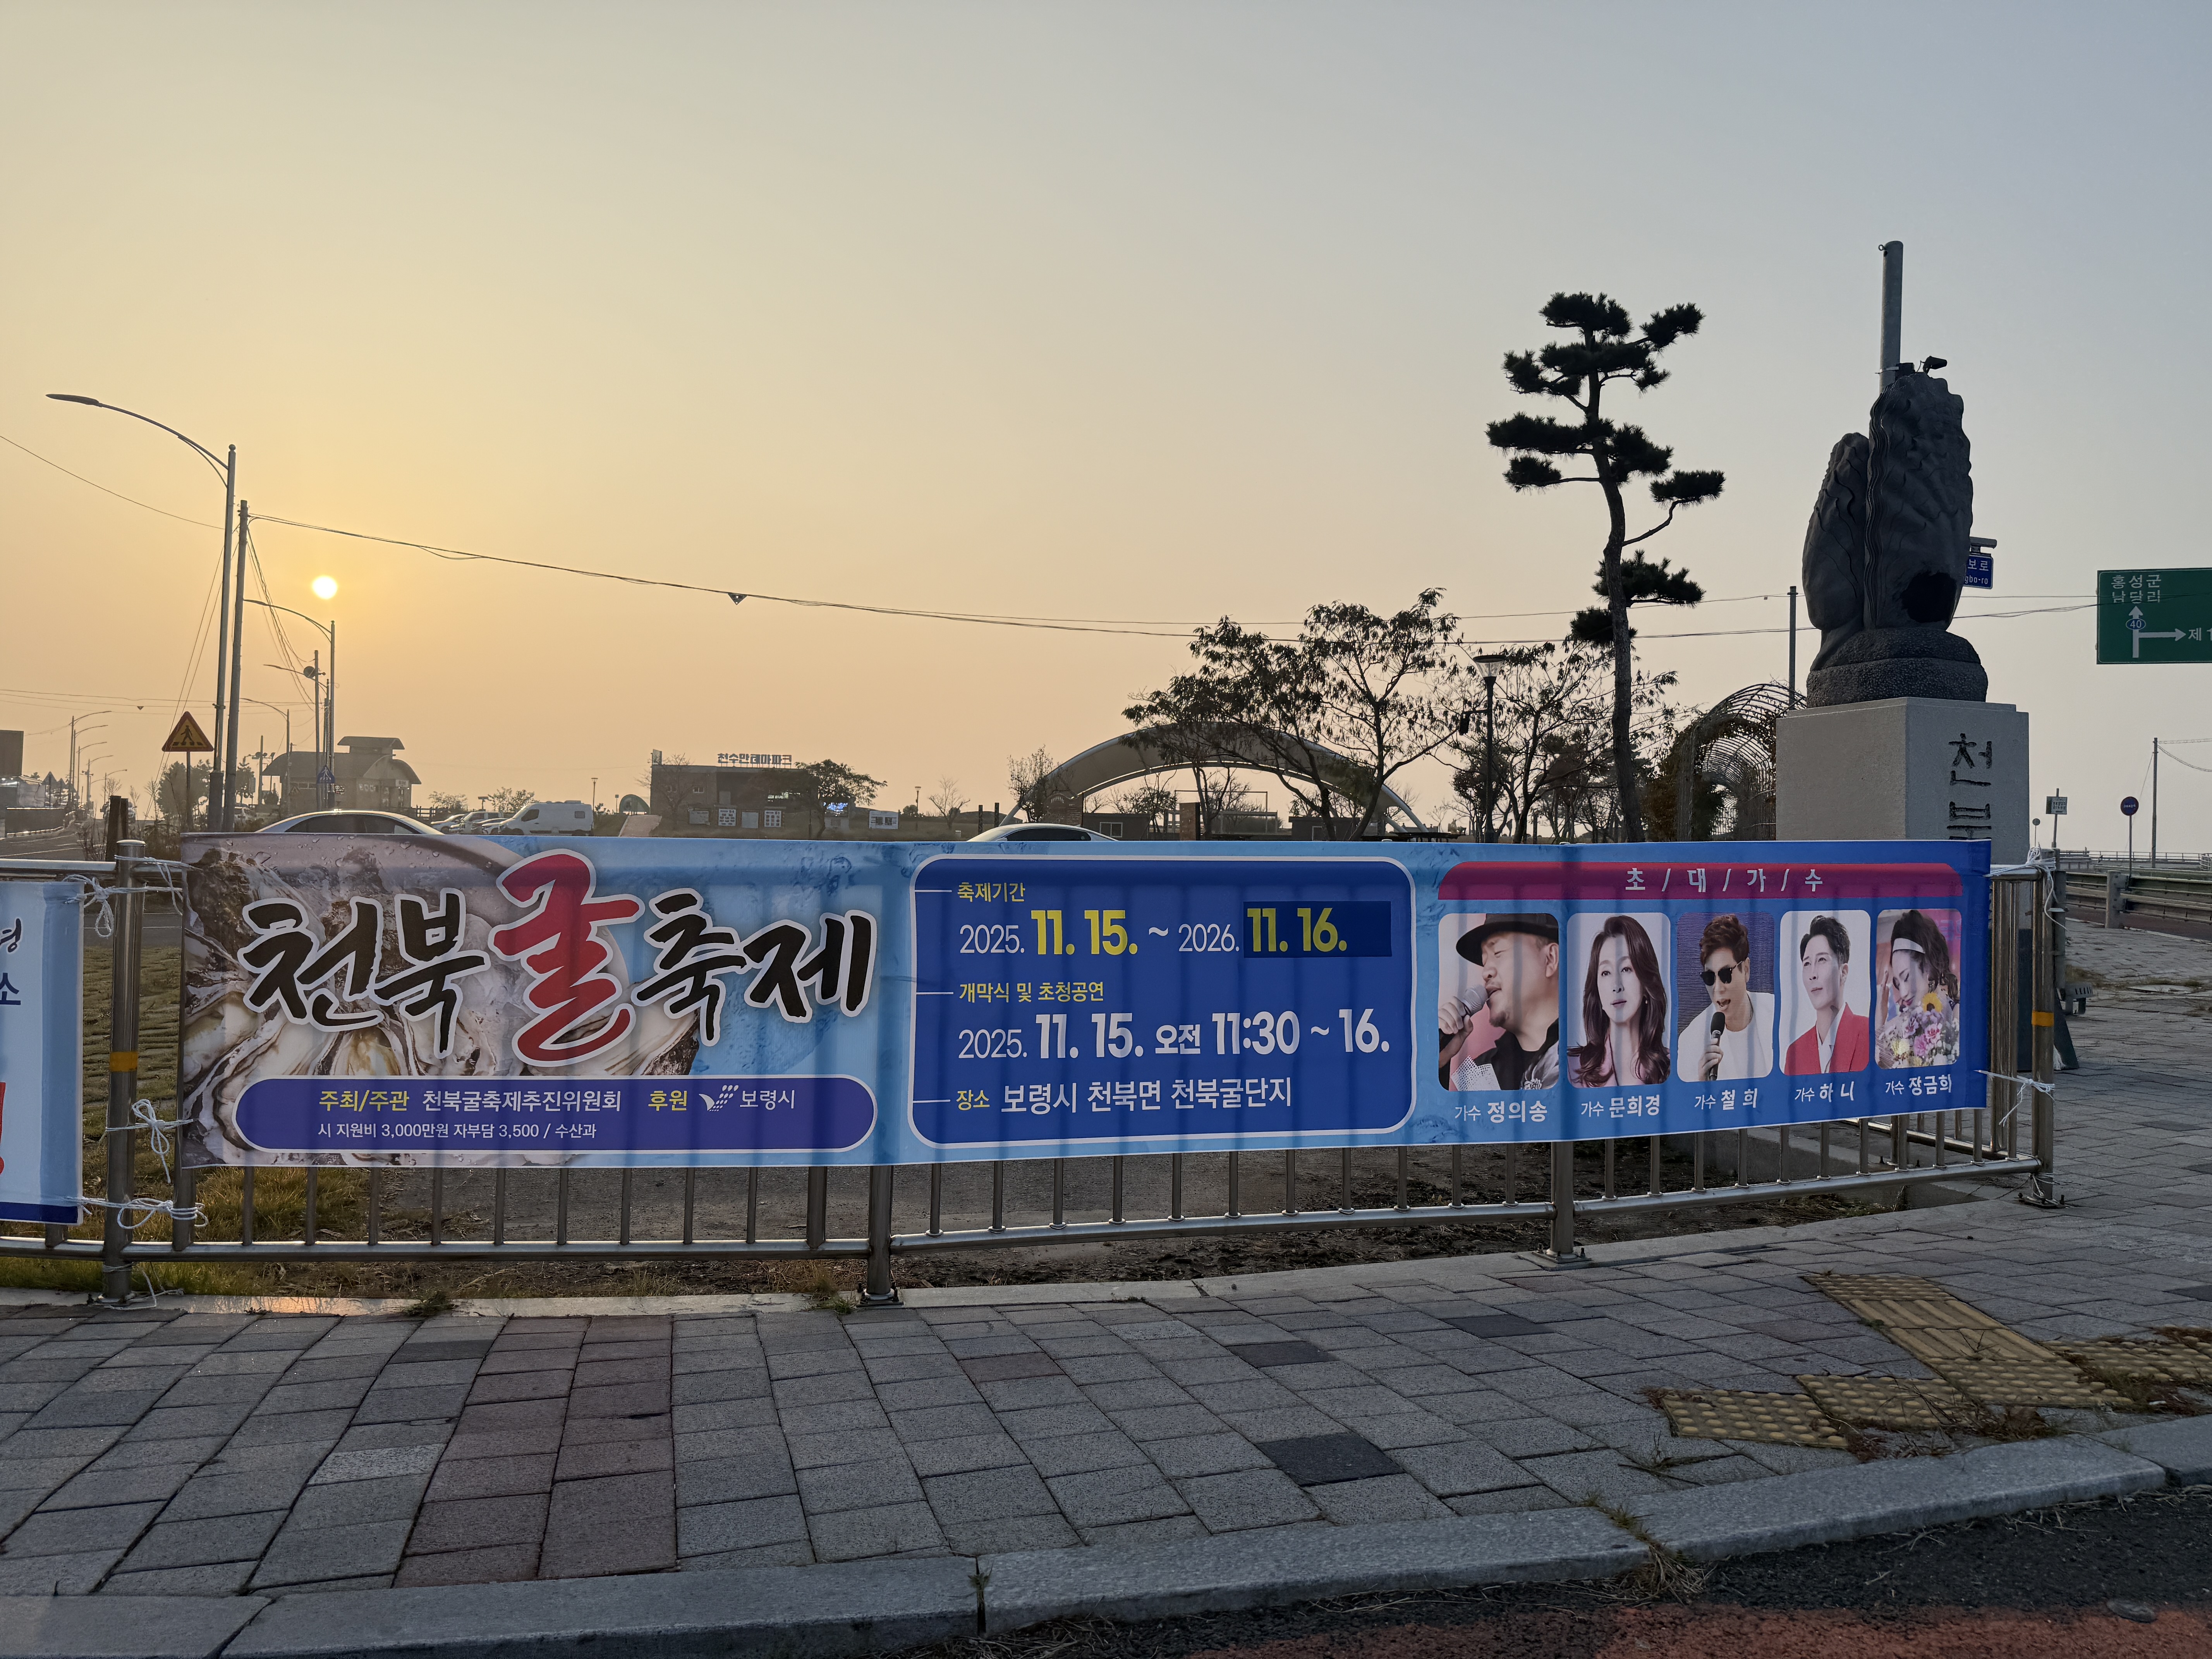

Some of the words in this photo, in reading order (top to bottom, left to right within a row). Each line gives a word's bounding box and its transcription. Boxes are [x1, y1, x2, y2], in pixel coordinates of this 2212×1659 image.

[1968, 559, 1989, 571] 보로
[1965, 575, 1988, 584] gbo-ro
[2111, 574, 2162, 589] 홍성군
[2112, 590, 2160, 604] 남당리
[2130, 620, 2142, 629] 40
[718, 753, 792, 765] 천수만테마파크
[1946, 733, 1992, 840] 천북
[957, 882, 1025, 903] 축제기간
[960, 924, 1025, 953] 2025.
[1031, 910, 1075, 955] 11.
[1085, 910, 1138, 955] 15.
[1178, 924, 1240, 952] 2026.
[1247, 908, 1288, 952] 11.
[1297, 908, 1347, 952] 16.
[960, 982, 1009, 1003] 개막식
[1017, 982, 1032, 1003] 및
[1038, 982, 1104, 1002] 초청공연
[958, 1029, 1027, 1058] 2025.
[1036, 1013, 1079, 1059] 11.
[1092, 1013, 1144, 1058] 15.
[1155, 1024, 1201, 1054] 오전
[1212, 1011, 1300, 1054] 11:30
[956, 1090, 990, 1111] 장소
[1001, 1082, 1077, 1115] 보령시
[1087, 1080, 1161, 1112] 천북면
[1171, 1077, 1291, 1109] 천북굴단지
[1795, 1087, 1815, 1101] 가수
[1885, 1080, 1905, 1095] 가수
[1908, 1075, 1952, 1096] 장금희
[319, 1090, 410, 1113] 주최/주관
[422, 1090, 621, 1113] 천북굴축제추진위원회
[648, 1090, 688, 1111] 후원
[740, 1089, 795, 1111] 보령시
[1581, 1101, 1604, 1118] 가수
[1609, 1094, 1661, 1118] 문희경
[1694, 1095, 1716, 1109] 가수
[1455, 1106, 1481, 1121] 가수
[1487, 1101, 1547, 1123] 정의송
[318, 1123, 331, 1138] 시
[337, 1123, 377, 1139] 지원비
[382, 1123, 449, 1139] 3,000만원
[453, 1123, 495, 1139] 자부담
[499, 1124, 540, 1139] 3,500
[555, 1123, 596, 1139] 수산과
